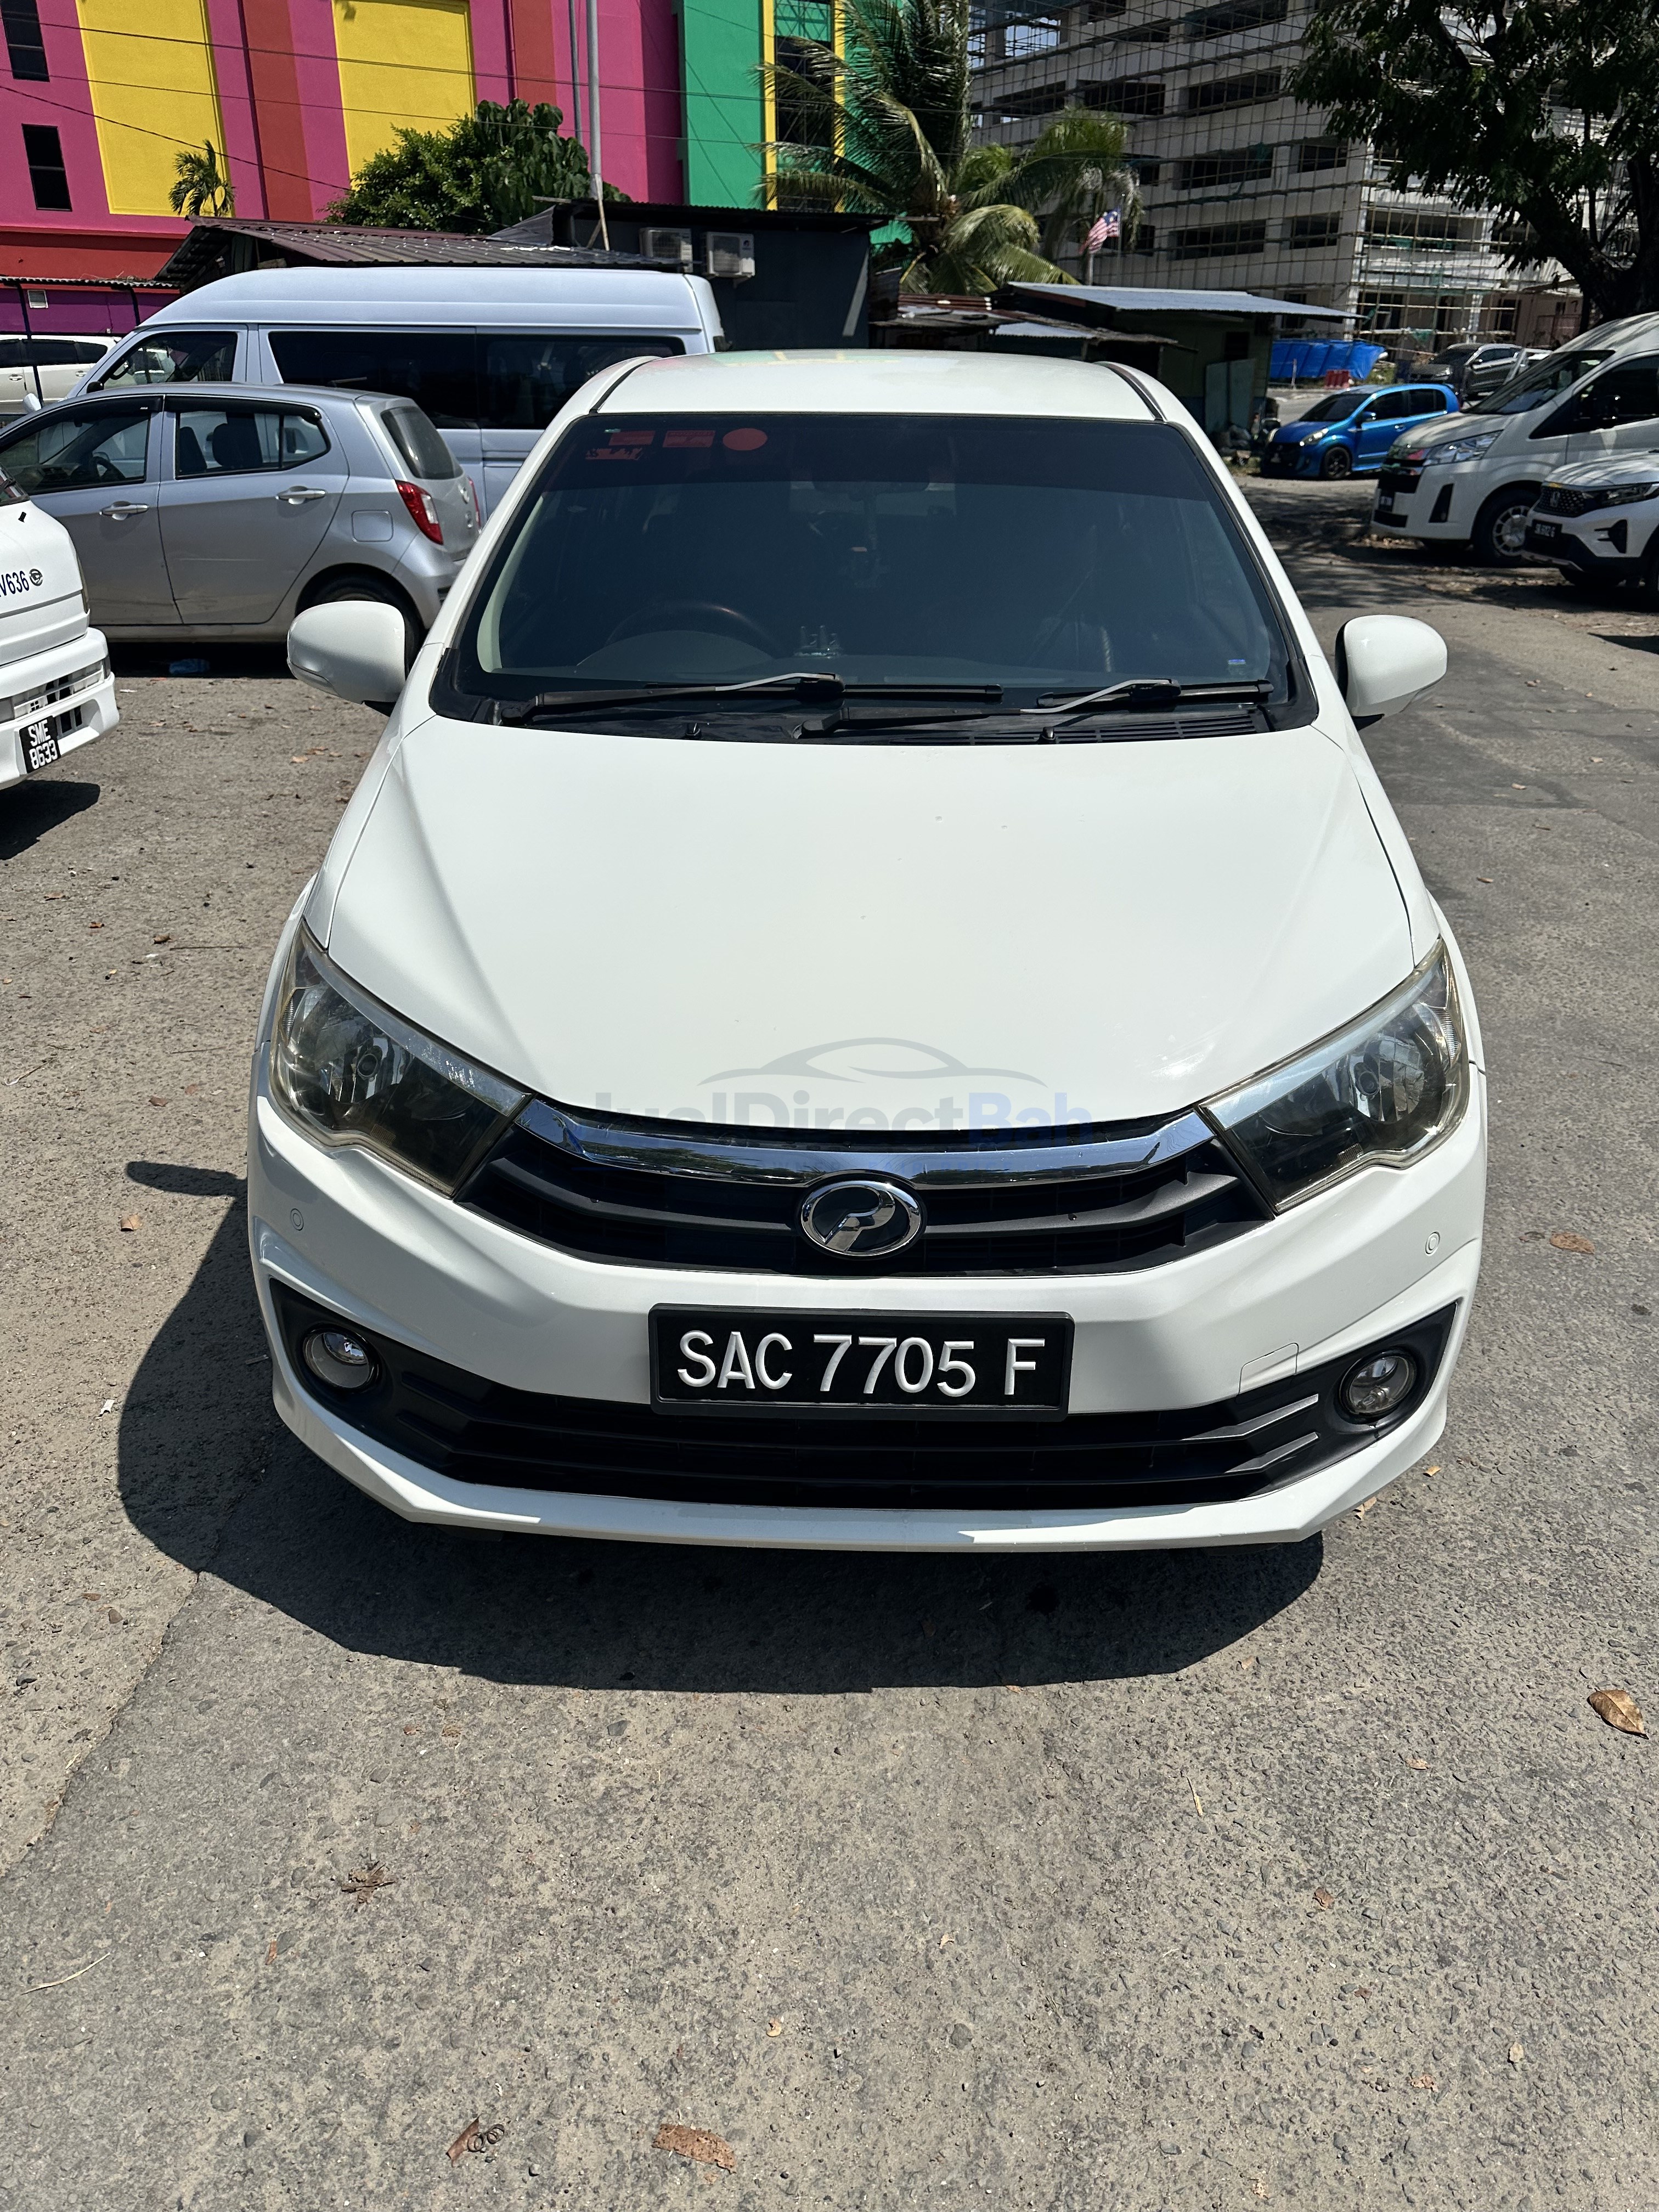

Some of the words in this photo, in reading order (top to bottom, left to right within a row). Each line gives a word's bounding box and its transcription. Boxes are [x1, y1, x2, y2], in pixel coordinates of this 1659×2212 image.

[0, 571, 30, 597] V636
[28, 719, 51, 746] SME
[29, 740, 58, 769] 8633
[677, 1330, 793, 1390] SAC
[813, 1334, 976, 1398] 7705
[1004, 1338, 1046, 1396] F
